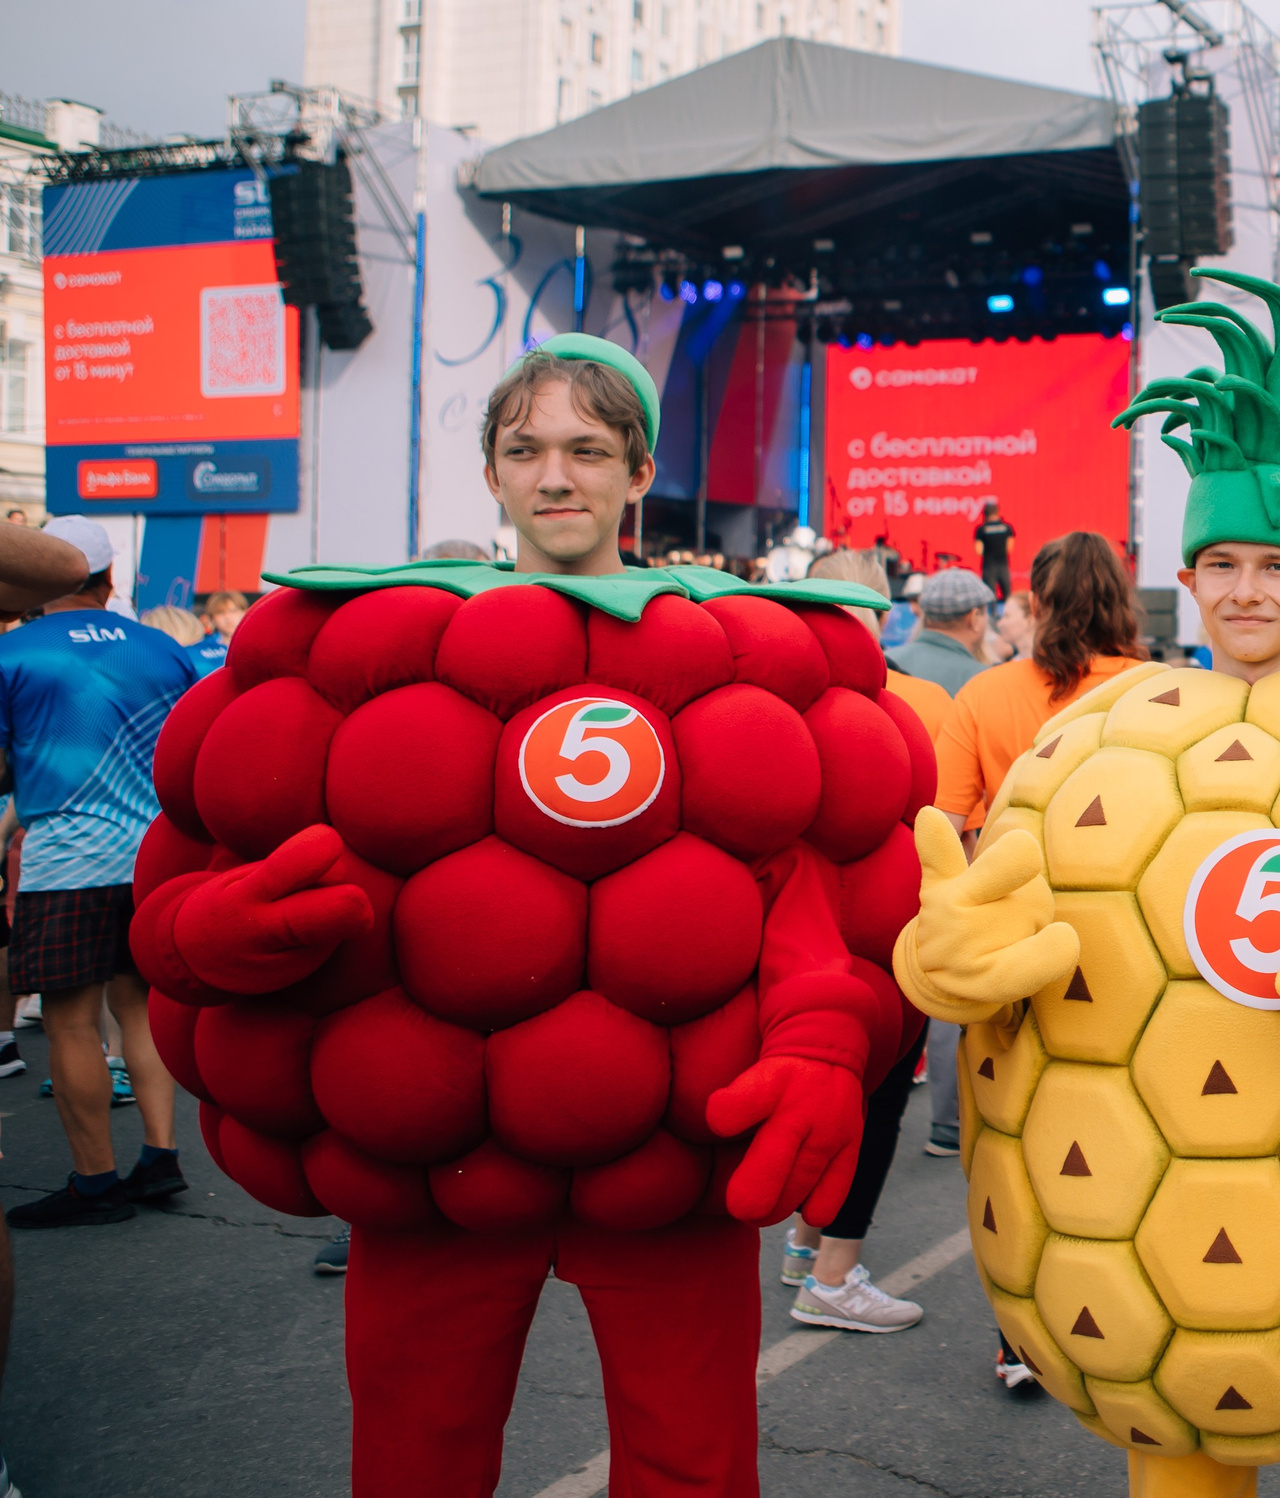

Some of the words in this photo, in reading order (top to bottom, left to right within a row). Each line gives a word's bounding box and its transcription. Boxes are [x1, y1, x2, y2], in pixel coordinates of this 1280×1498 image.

[67, 315, 154, 339] бесплатной
[54, 337, 131, 361] доставкой
[54, 366, 71, 381] от
[90, 362, 134, 383] минут
[875, 366, 978, 387] самокат
[848, 438, 866, 459] с
[870, 430, 1037, 459] бесплатной
[848, 461, 992, 489] доставкой
[848, 496, 877, 517] от
[884, 490, 909, 516] 15
[555, 702, 639, 803] 5
